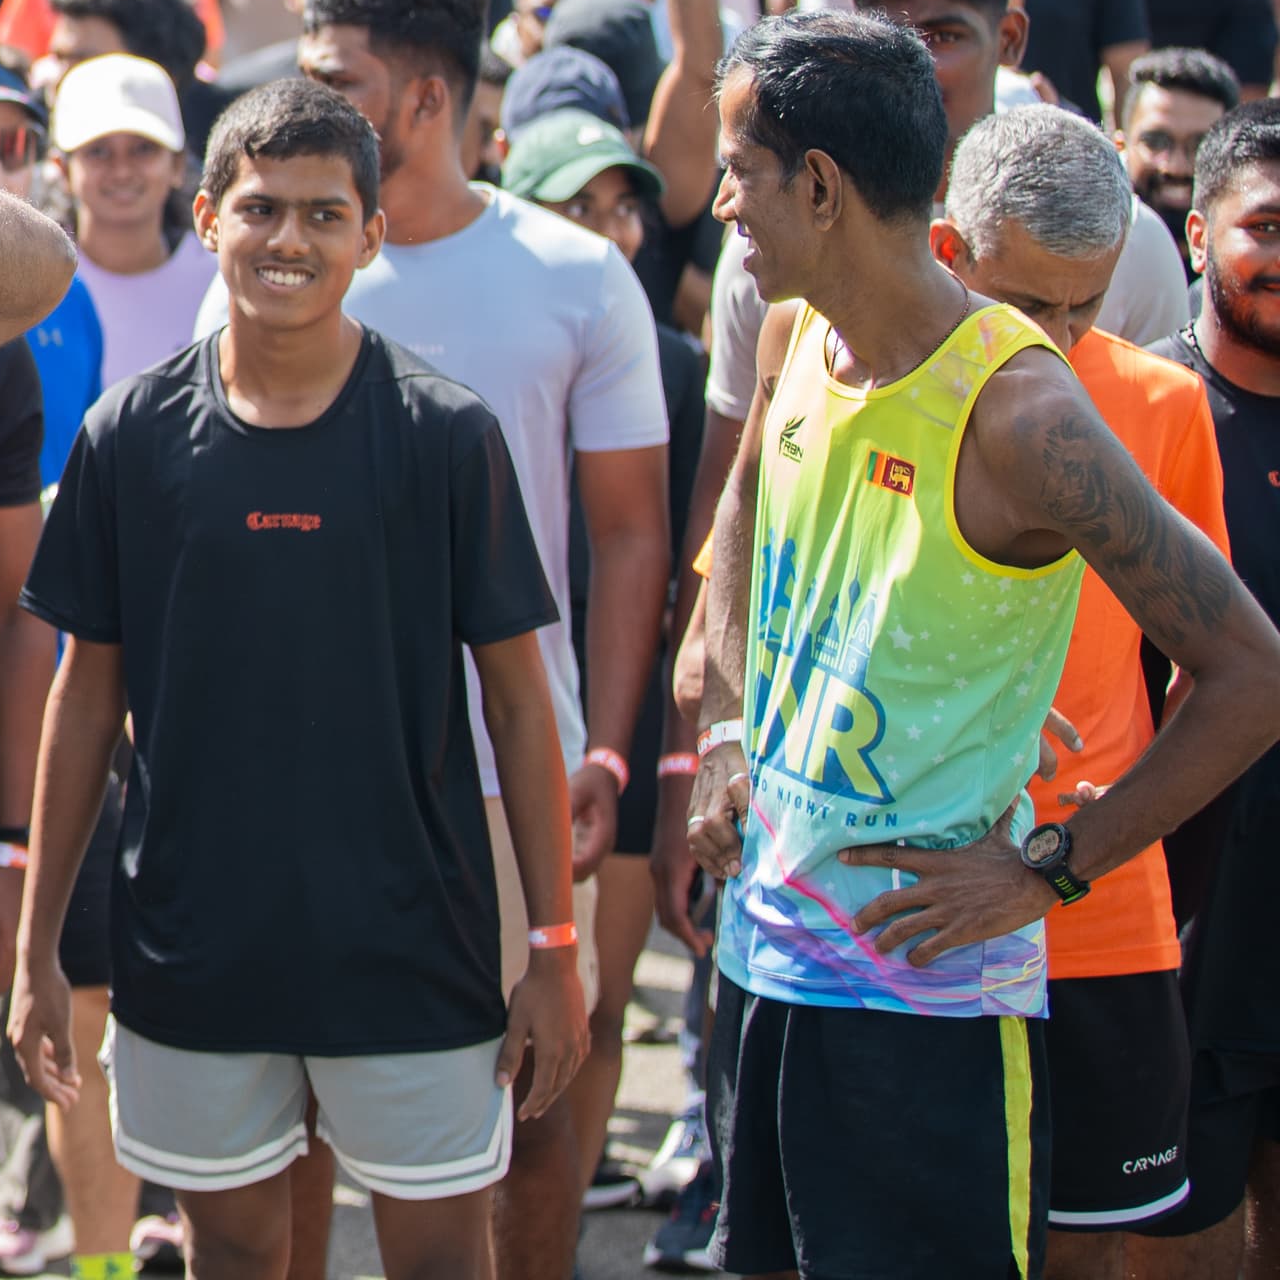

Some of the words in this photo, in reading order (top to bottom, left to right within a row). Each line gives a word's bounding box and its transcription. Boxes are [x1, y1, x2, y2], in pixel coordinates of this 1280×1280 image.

[777, 783, 830, 820] NIGHT
[845, 812, 898, 827] RUN
[1122, 1145, 1178, 1174] CARNAGE
